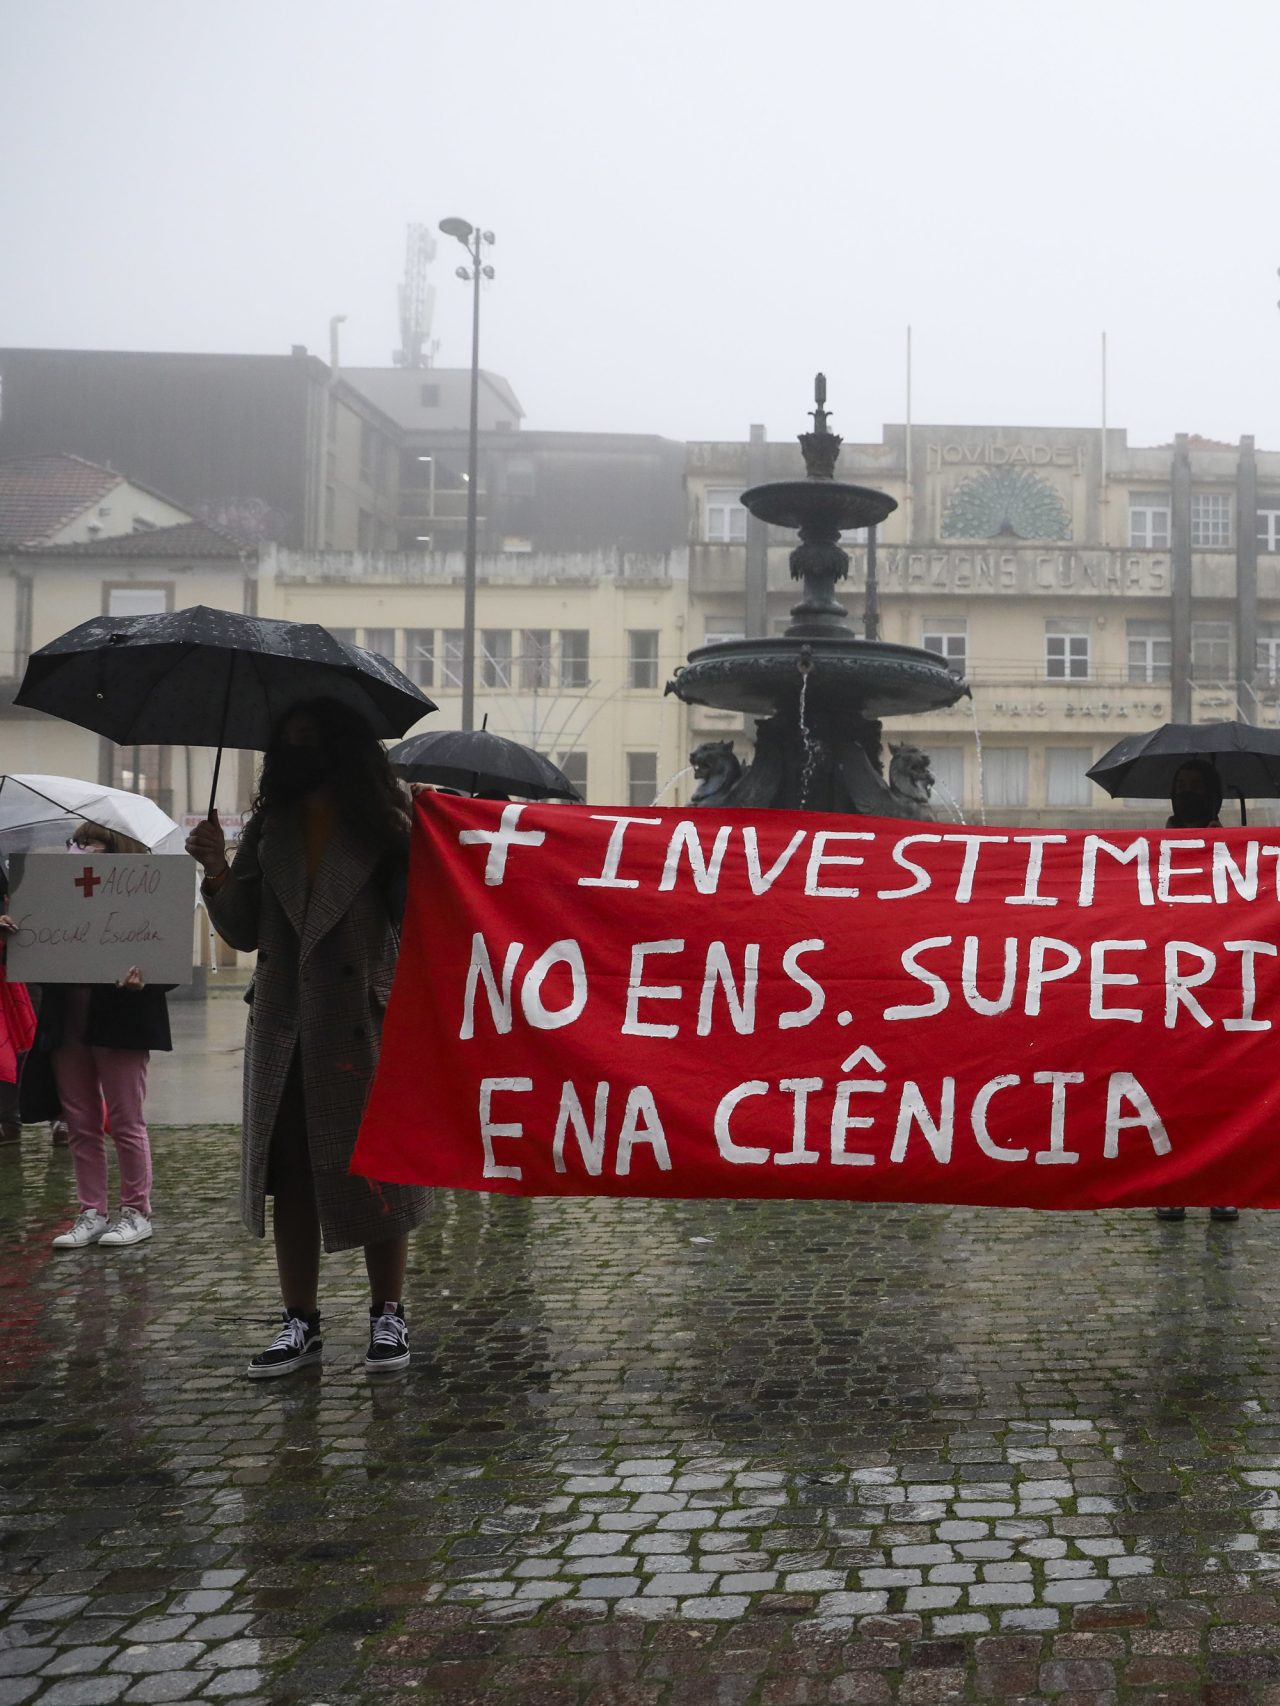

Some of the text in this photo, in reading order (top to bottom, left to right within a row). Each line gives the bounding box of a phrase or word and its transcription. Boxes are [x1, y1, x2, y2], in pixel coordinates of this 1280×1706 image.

[1036, 554, 1167, 591] CUNHAS
[459, 932, 588, 1040] NO
[621, 938, 853, 1039] ENS.
[713, 1045, 1173, 1167] CIÊNCIA
